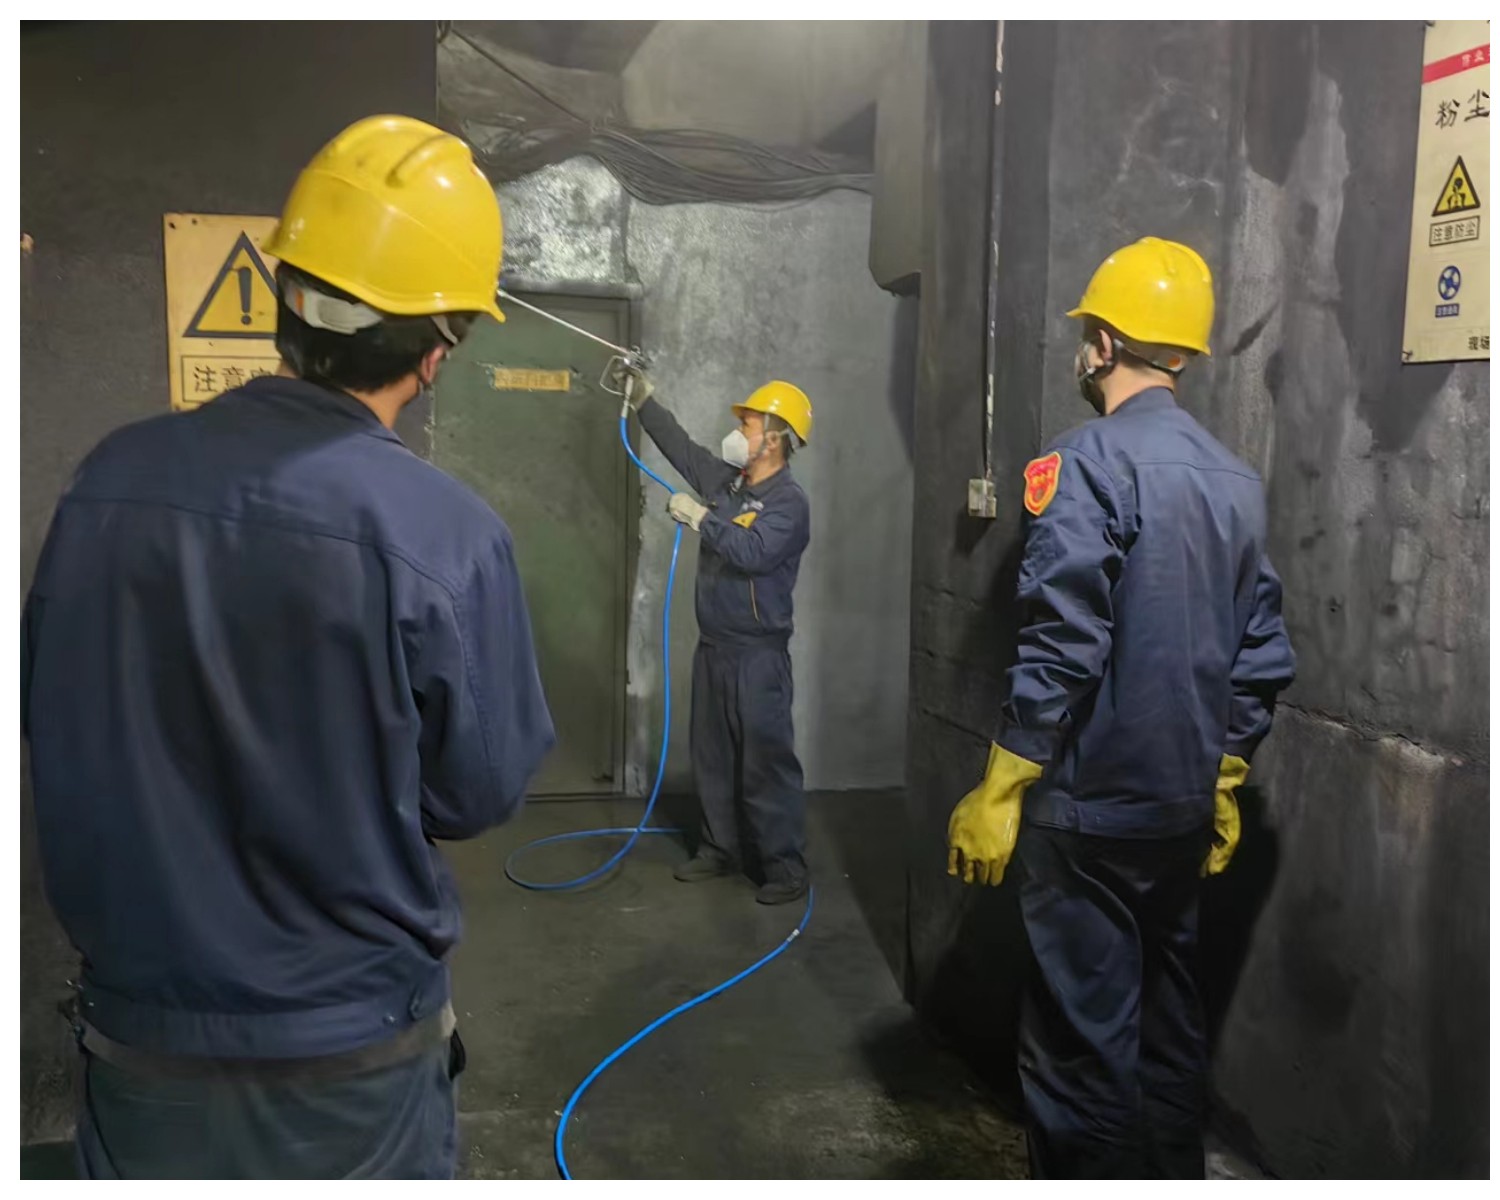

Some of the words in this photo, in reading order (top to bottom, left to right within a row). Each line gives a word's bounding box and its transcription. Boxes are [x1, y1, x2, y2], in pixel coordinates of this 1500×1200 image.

[1435, 89, 1489, 128] 粉尘
[1433, 220, 1476, 242] 注意防尘
